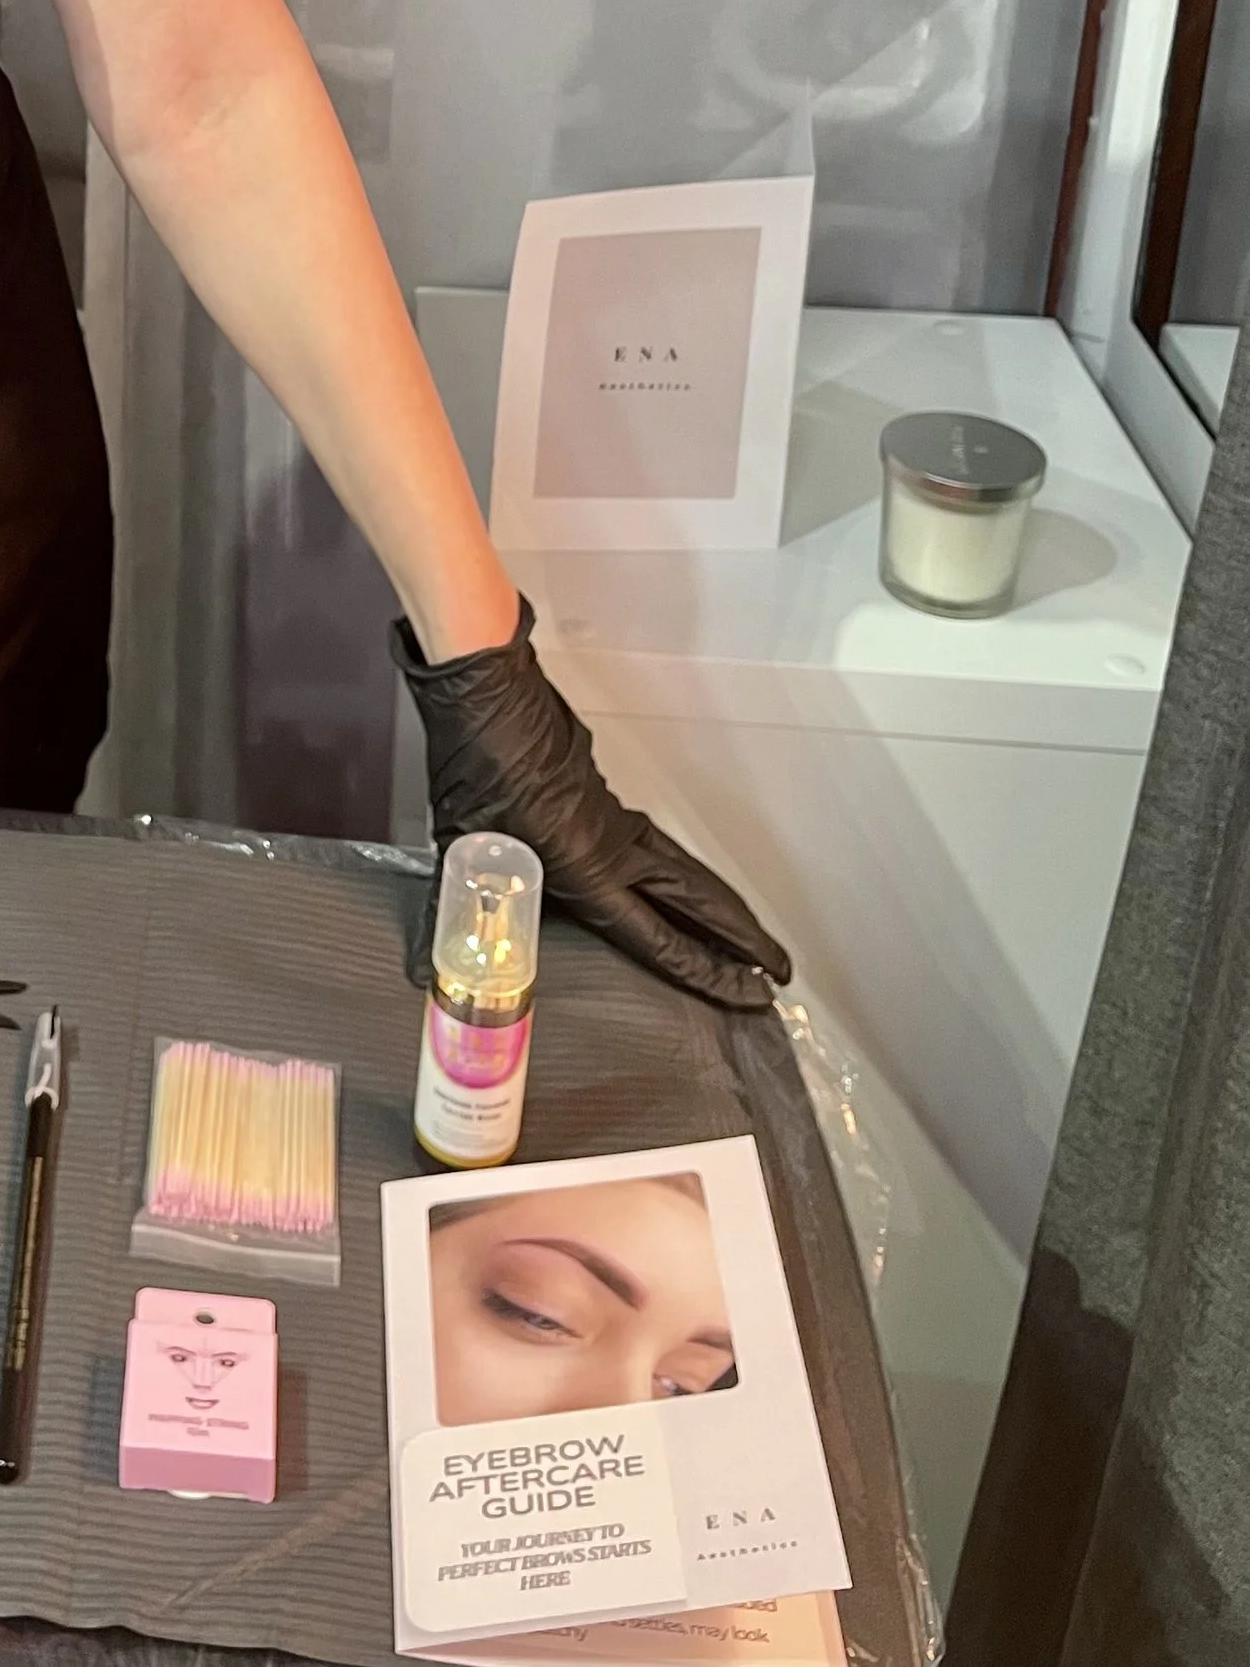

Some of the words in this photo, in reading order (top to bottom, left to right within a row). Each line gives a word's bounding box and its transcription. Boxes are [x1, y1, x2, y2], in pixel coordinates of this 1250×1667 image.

[443, 1434, 625, 1477] EYEBROW
[428, 1455, 645, 1502] AFTERCARE
[481, 1485, 596, 1519] GUIDE
[460, 1537, 511, 1558] YOUR
[512, 1525, 598, 1552] JOURNEY
[598, 1522, 625, 1540] TO
[437, 1556, 518, 1581] PERFECT
[520, 1546, 588, 1571] BROWS
[588, 1539, 652, 1561] STARTS
[519, 1570, 571, 1591] HERE
[690, 1625, 729, 1642] may
[732, 1625, 770, 1643] look
